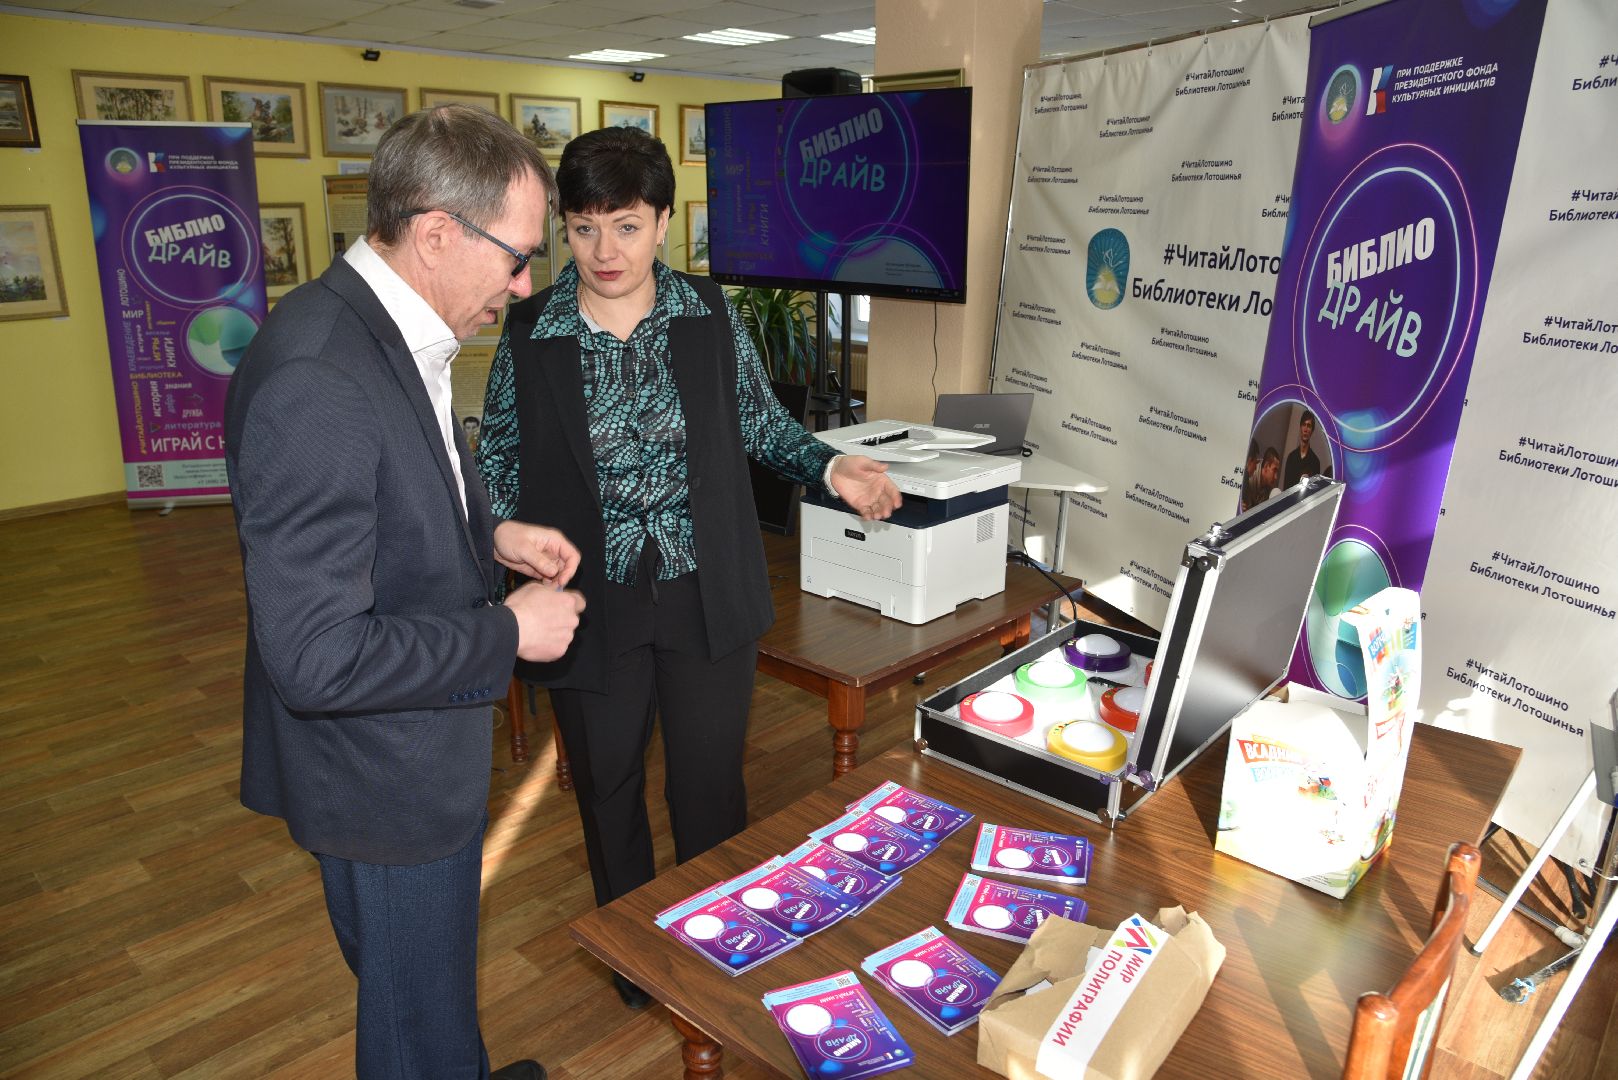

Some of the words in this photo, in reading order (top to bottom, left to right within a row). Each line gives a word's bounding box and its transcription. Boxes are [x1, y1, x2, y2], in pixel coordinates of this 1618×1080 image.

[1186, 66, 1245, 82] #ЧитайЛотошино
[1394, 71, 1464, 91] ПРЕЗИДЕНТСКОГО
[1465, 62, 1498, 78] ФОНДА
[1396, 68, 1412, 79] ПРИ
[1413, 57, 1463, 76] ПОДДЕРЖКЕ
[1572, 76, 1618, 91] Библи
[1175, 84, 1216, 97] Библиотеки
[1216, 78, 1251, 93] Лотошинья
[1391, 87, 1442, 104] КУЛЬТУРНЫХ
[1443, 76, 1496, 96] ИНИЦИАТИВ
[1272, 110, 1304, 122] Библиоте
[799, 107, 884, 160] БИБЛИО
[799, 154, 886, 192] ДРАЙВ
[1261, 208, 1290, 218] Библио
[144, 214, 226, 247] БИБЛИО
[148, 242, 232, 268] ДРАЙВ
[1163, 243, 1281, 275] #ЧитайЛото
[1326, 217, 1436, 288] БИБЛИО
[117, 268, 130, 307] ЛОТОШИНО
[1132, 278, 1240, 312] Библиотеки
[122, 310, 144, 319] МИР
[1317, 279, 1422, 358] ДРАЙВ
[1543, 315, 1618, 334] #ЧитайЛот
[164, 337, 176, 368] КНИГИ
[1522, 332, 1598, 352] Библиотеки
[151, 431, 202, 453] ИГРАЙ
[205, 435, 215, 450] С
[1518, 436, 1618, 468] #ЧитайЛотоши
[1220, 475, 1242, 490] Библи
[1499, 449, 1569, 476] Библиотеки
[1569, 467, 1618, 489] Лотош
[1491, 550, 1601, 595] #ЧитайЛотошино
[1469, 561, 1540, 594] Библиотеки
[1540, 586, 1617, 620] Лотошинья
[1465, 658, 1569, 712] #ЧитайЛотошино
[1446, 667, 1511, 705] Библиотеки
[1512, 698, 1584, 737] Лотошинья
[1122, 953, 1144, 984] МИР
[1052, 950, 1123, 1047] ПОЛИГРАФИИ
